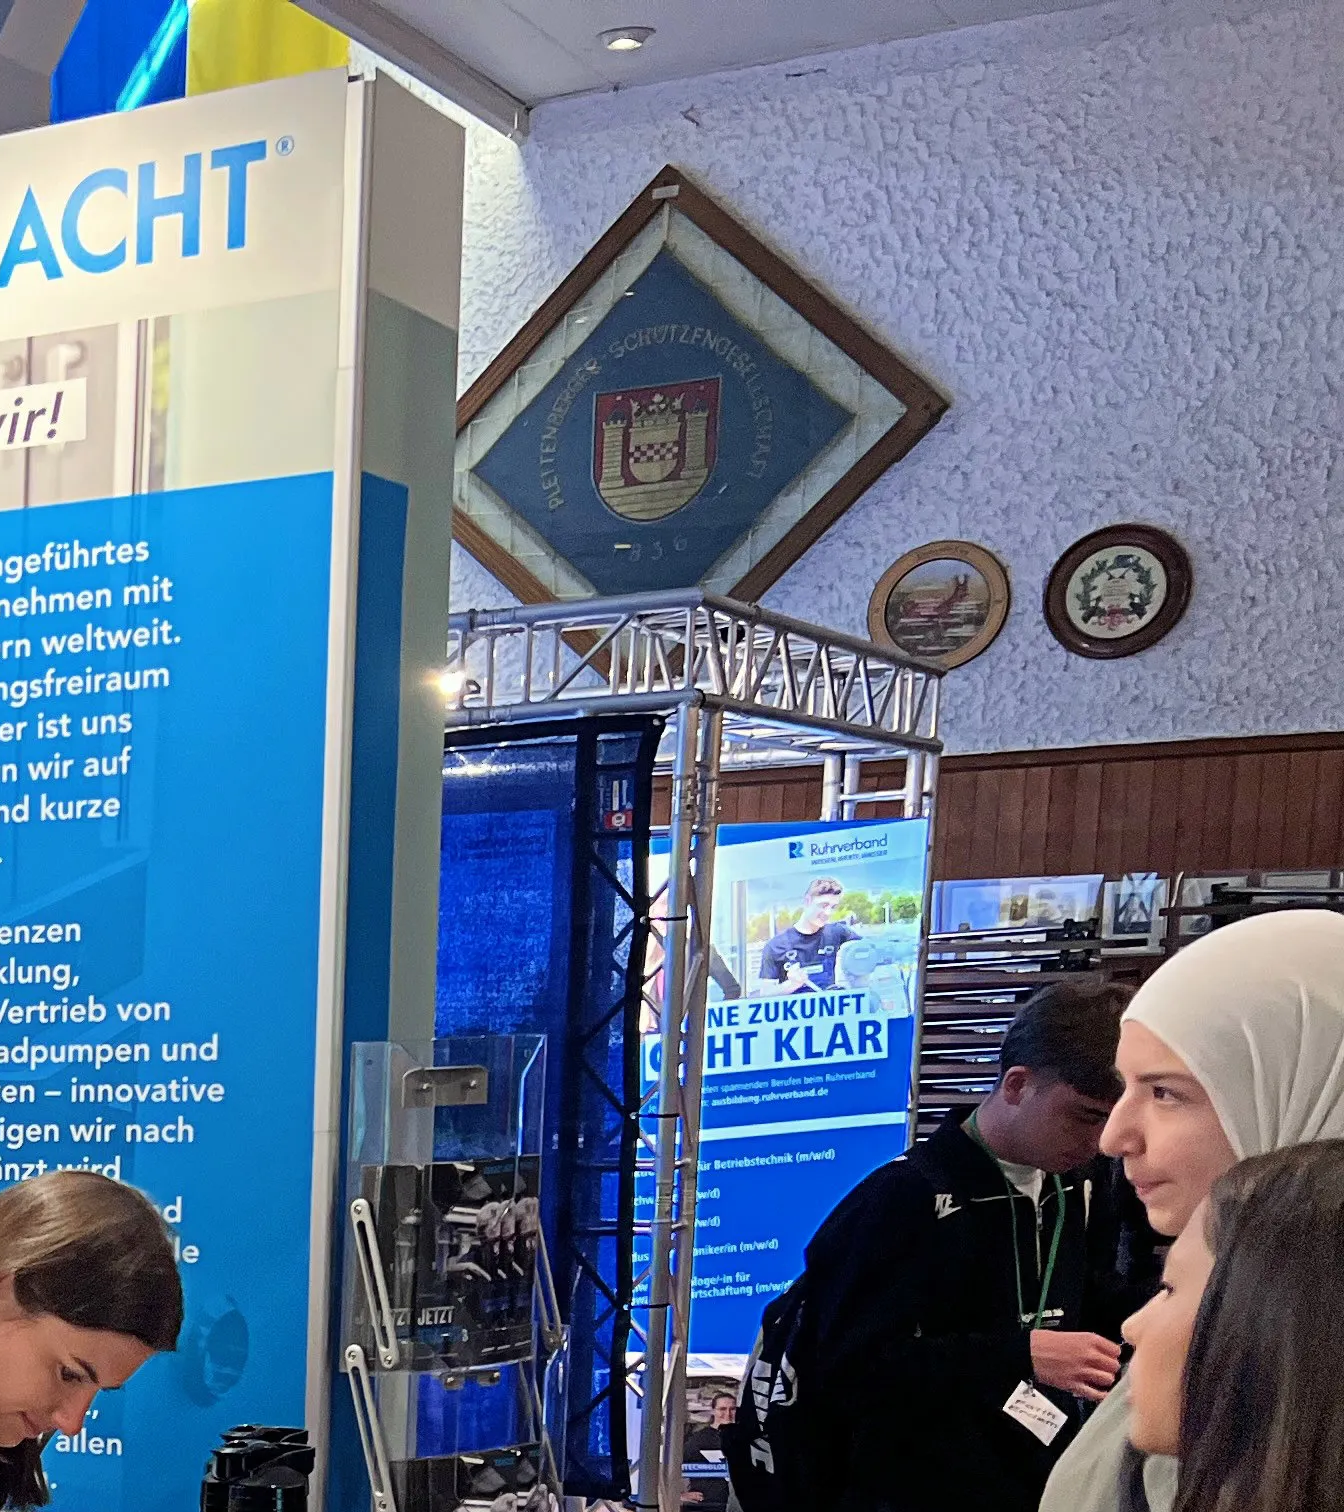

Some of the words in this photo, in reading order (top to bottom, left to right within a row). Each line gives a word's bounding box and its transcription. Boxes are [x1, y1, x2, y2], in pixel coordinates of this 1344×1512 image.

[122, 576, 173, 605] mit
[41, 619, 182, 656] weltweit.
[37, 711, 72, 739] ist
[81, 709, 133, 737] uns
[27, 753, 74, 782] wir
[83, 745, 132, 777] auf
[40, 791, 121, 822] kurze
[811, 833, 888, 857] Ruhrverband
[117, 999, 172, 1024] von
[749, 994, 865, 1023] ZUKUNFT
[161, 1033, 220, 1063] und
[774, 1020, 883, 1063] KLAR
[70, 1076, 226, 1104] innovative
[70, 1116, 116, 1144] wir
[125, 1116, 195, 1144] nach
[714, 1152, 793, 1170] Betriebstechnik
